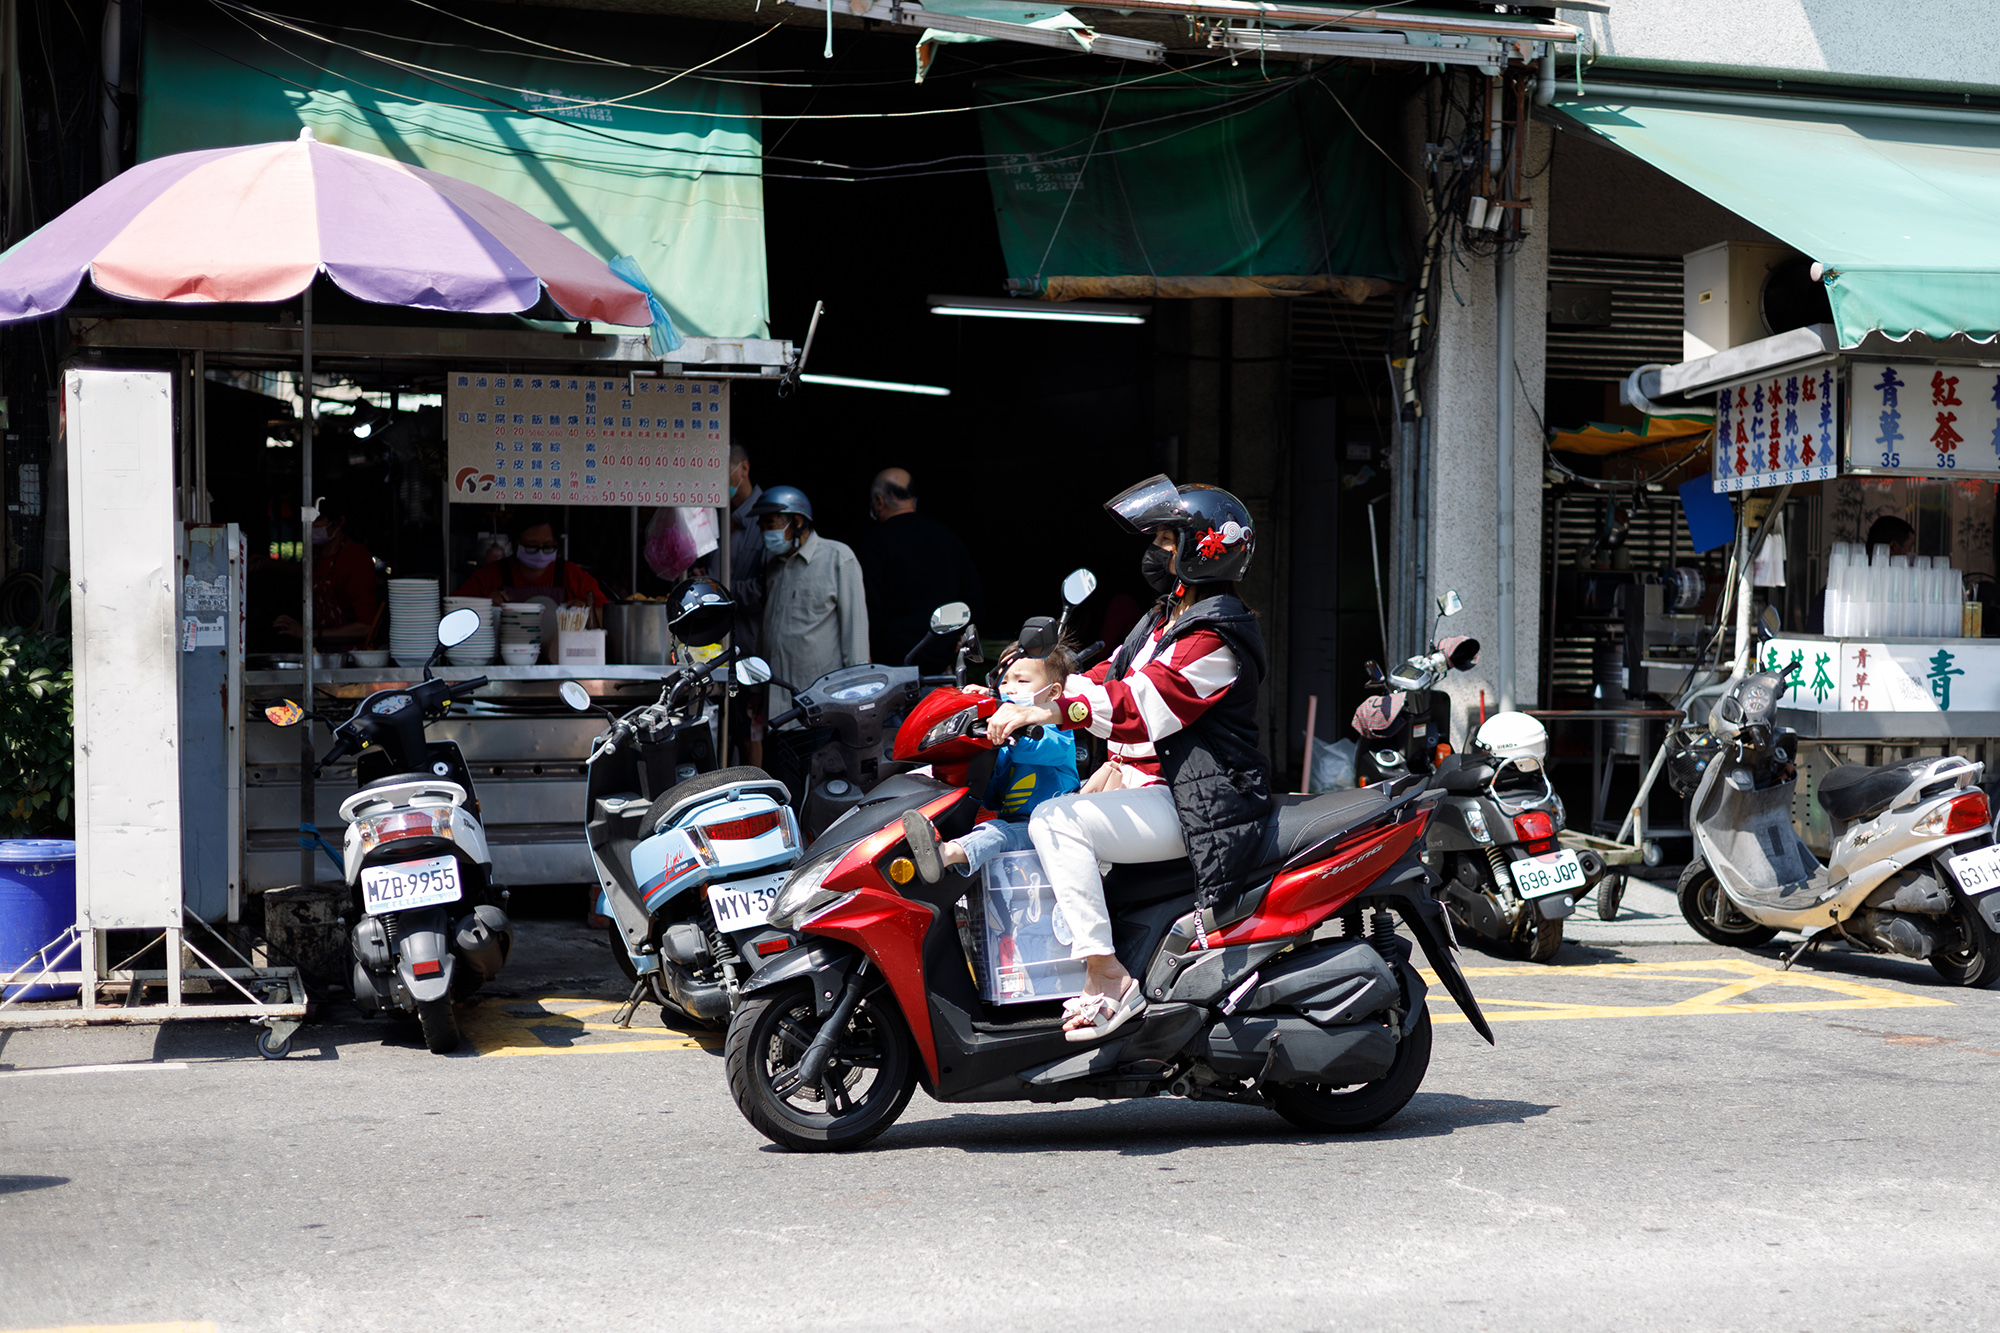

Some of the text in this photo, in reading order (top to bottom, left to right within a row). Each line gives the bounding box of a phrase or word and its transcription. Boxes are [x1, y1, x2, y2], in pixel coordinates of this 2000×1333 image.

[656, 383, 667, 428] 米粉
[1873, 366, 1905, 454] 青草
[1930, 370, 1964, 454] 紅茶
[1800, 374, 1817, 467] 紅茶
[495, 426, 505, 435] 20
[513, 427, 524, 436] 20
[568, 429, 578, 437] 40
[586, 429, 596, 437] 65
[602, 455, 615, 465] 40
[620, 455, 633, 466] 40
[638, 456, 651, 467] 40
[655, 456, 668, 467] 40
[673, 457, 686, 467] 40
[690, 457, 703, 468] 40
[707, 457, 720, 468] 40
[1881, 452, 1900, 468] 35
[1936, 453, 1956, 469] 35
[1784, 471, 1793, 484] 35
[1801, 469, 1810, 481] 35
[1819, 467, 1828, 479] 35
[1735, 478, 1743, 490] 35
[1752, 476, 1760, 488] 35
[1768, 473, 1777, 486] 35
[1720, 480, 1729, 492] 55
[496, 491, 506, 500] 25
[514, 491, 524, 500] 25
[532, 491, 542, 500] 40
[551, 492, 561, 500] 40
[569, 492, 579, 501] 40
[602, 491, 616, 502] 50
[620, 491, 633, 502] 50
[638, 492, 651, 502] 50
[655, 492, 668, 502] 50
[673, 492, 686, 503] 50
[690, 492, 703, 503] 50
[707, 493, 720, 504] 50
[1926, 649, 1965, 711] 青
